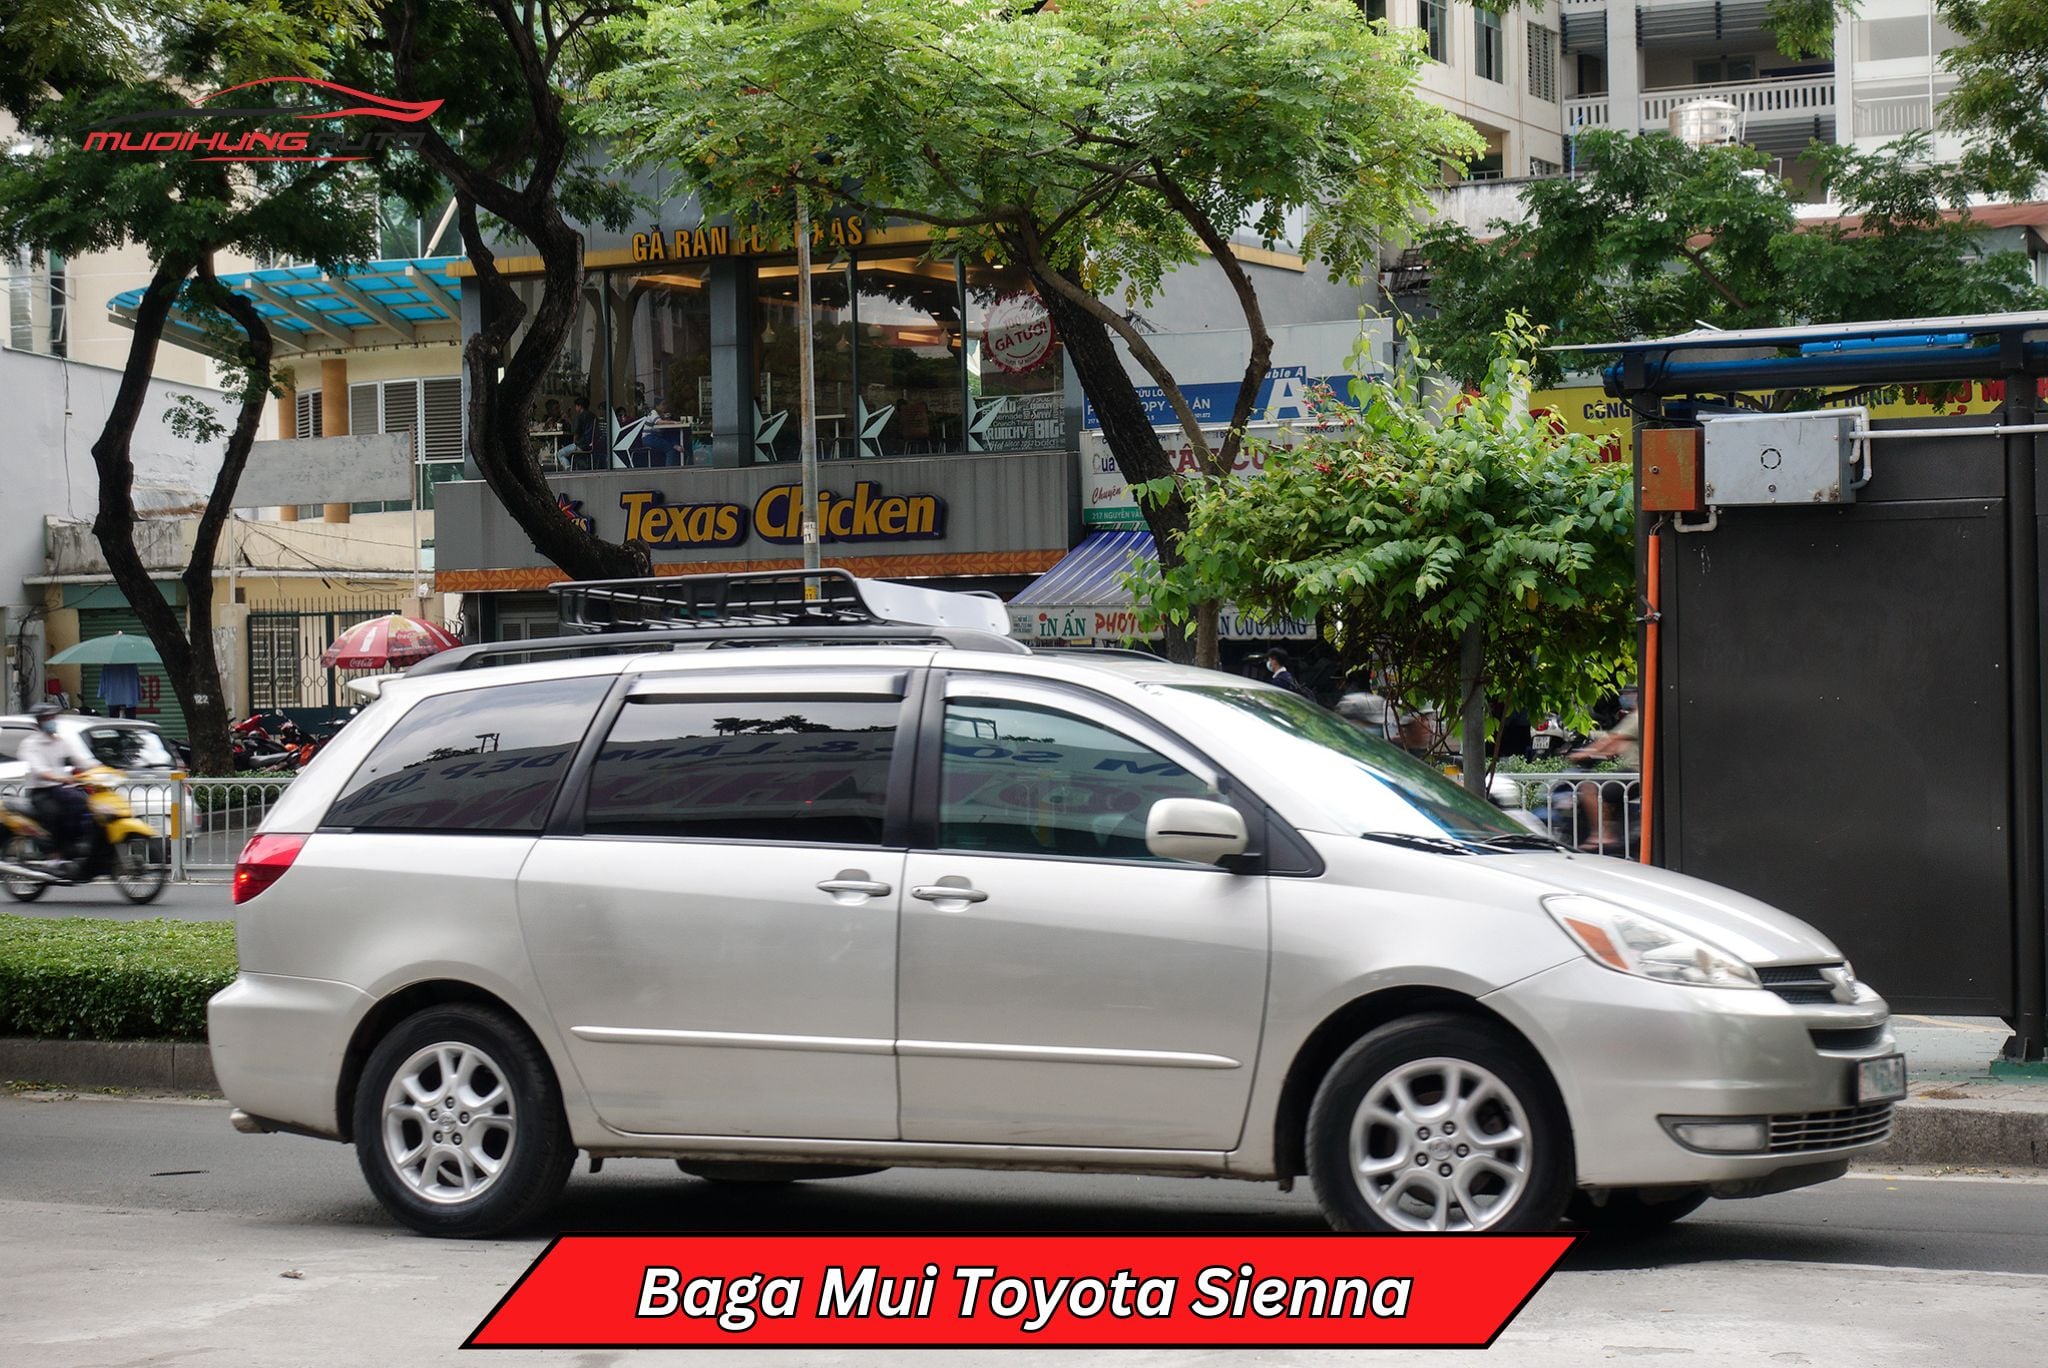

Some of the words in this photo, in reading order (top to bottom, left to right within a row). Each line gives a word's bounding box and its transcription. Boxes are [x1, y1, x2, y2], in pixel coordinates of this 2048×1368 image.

[632, 224, 665, 262] GÀ
[1264, 377, 1308, 421] A
[1034, 419, 1060, 439] BIG
[1091, 485, 1121, 504] Chuyên
[620, 491, 739, 546] Texas
[752, 480, 938, 540] Chicken
[1061, 607, 1086, 637] ẤN
[193, 693, 209, 705] 122
